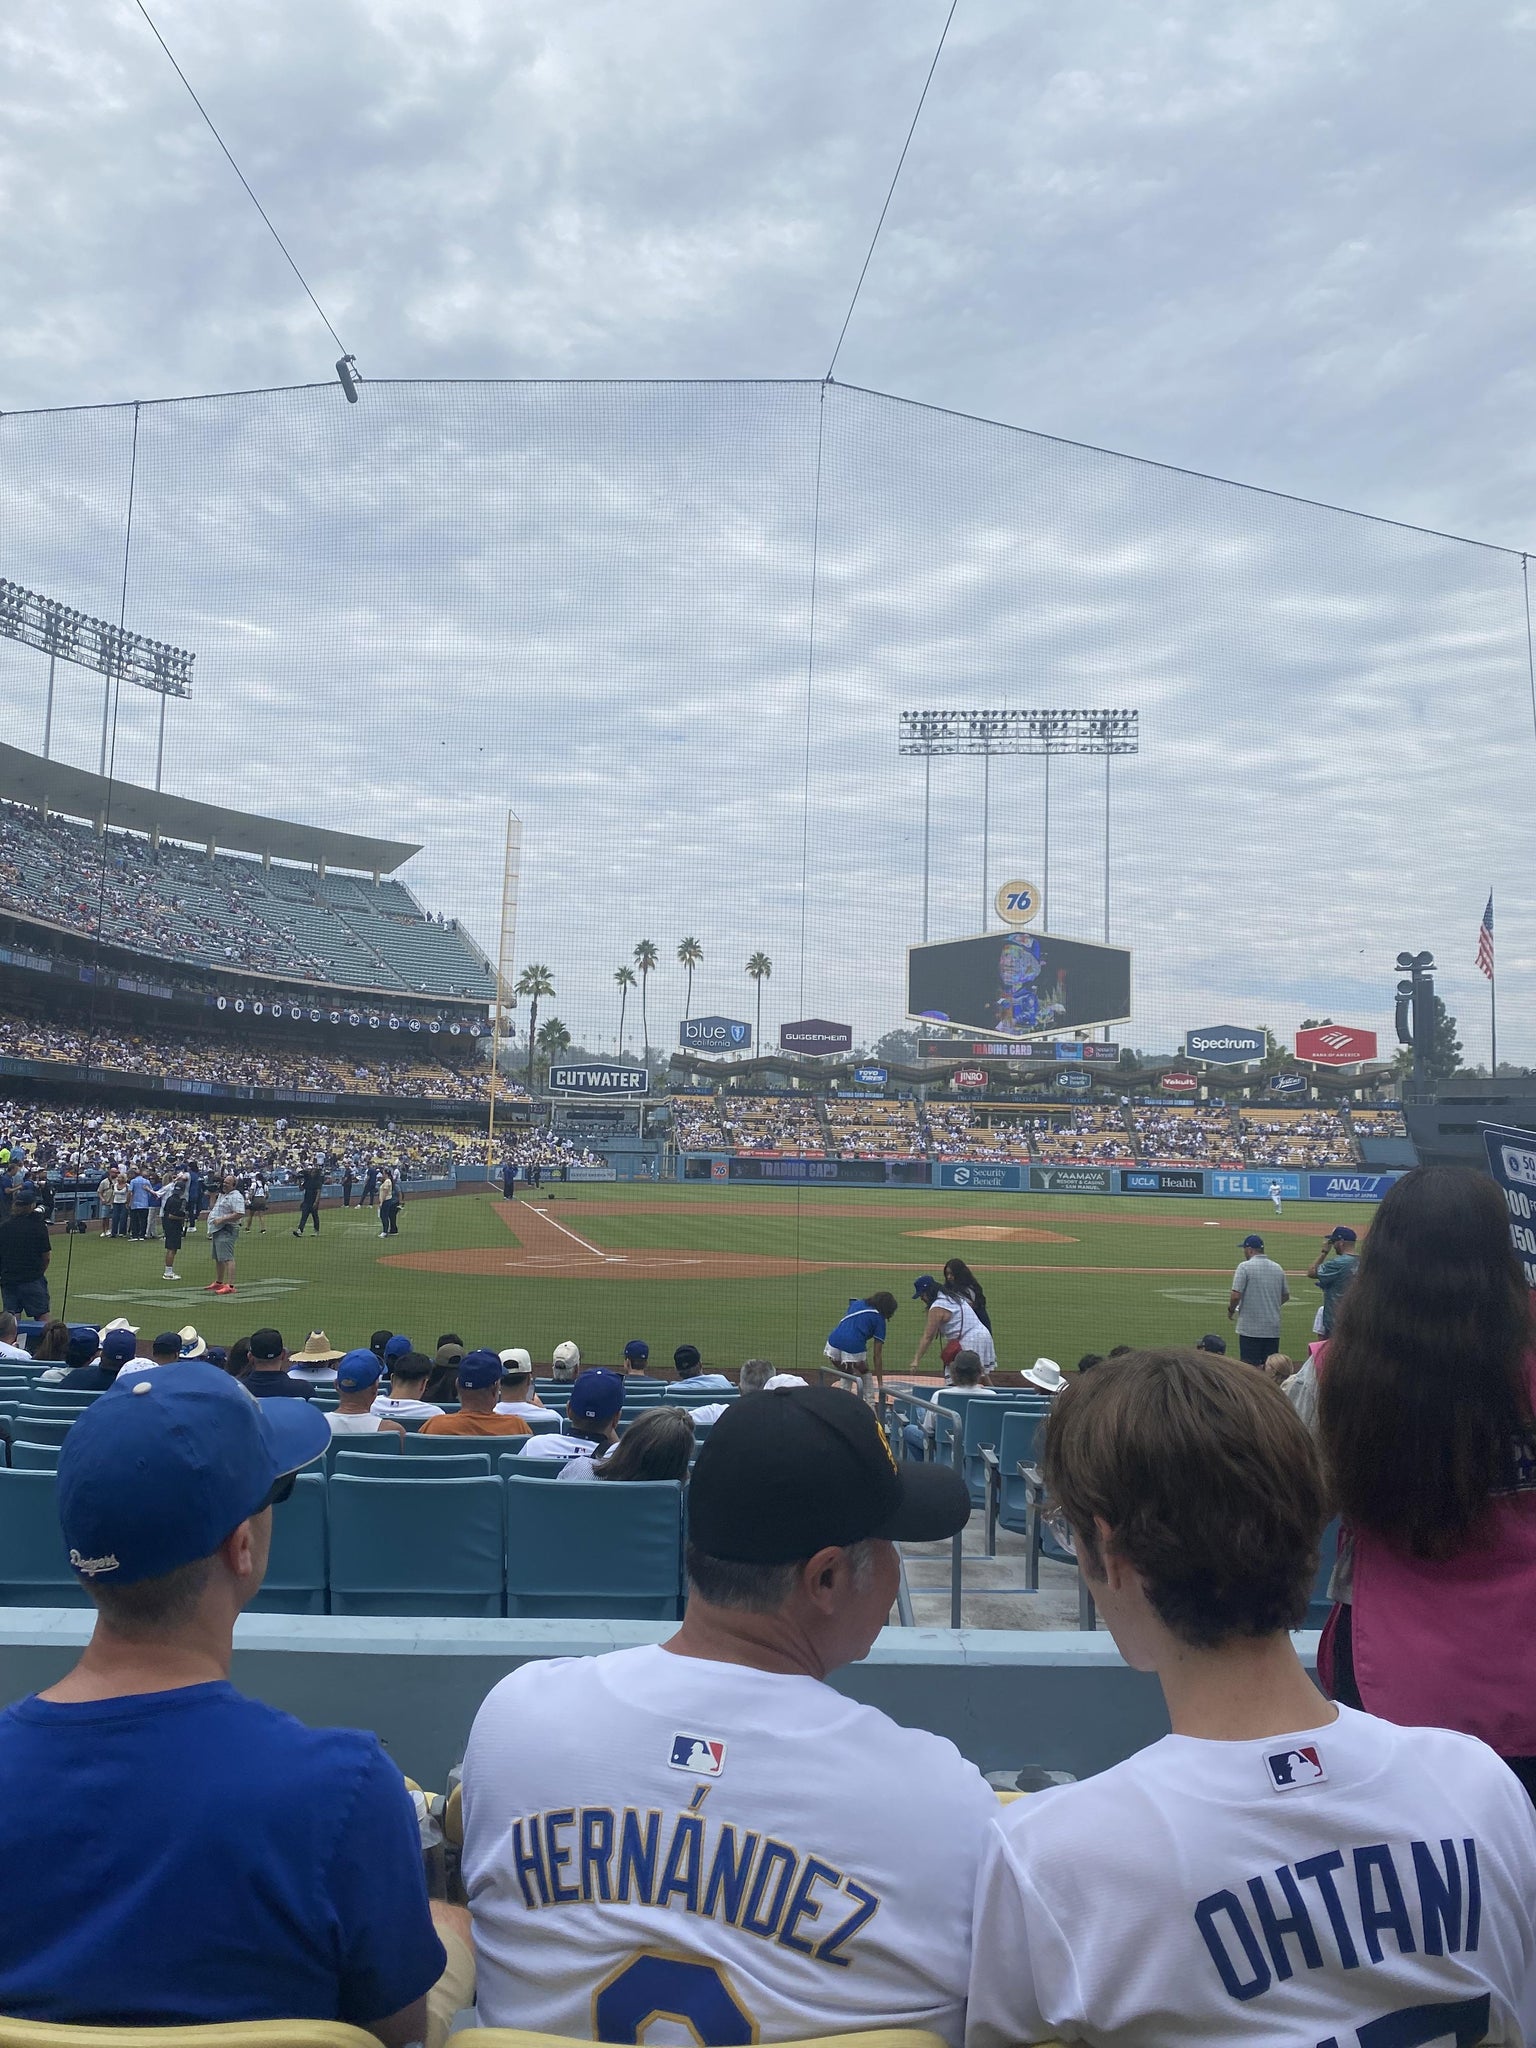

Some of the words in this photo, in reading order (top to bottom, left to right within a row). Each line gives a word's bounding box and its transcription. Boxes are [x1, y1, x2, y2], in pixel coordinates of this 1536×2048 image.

[1007, 891, 1031, 910] 76
[220, 999, 224, 1007] 1
[237, 1002, 242, 1010] 2
[256, 1005, 261, 1013] 4
[312, 1011, 319, 1020] 20
[331, 1013, 339, 1021] 24
[350, 1016, 359, 1024] 32
[370, 1018, 379, 1026] 34
[390, 1020, 399, 1028] 39
[410, 1022, 420, 1031] 42
[686, 1023, 725, 1039] blue
[786, 1033, 847, 1041] GUGGENHEIM
[1192, 1037, 1255, 1052] Spectrum
[972, 1044, 1007, 1055] TRADING
[1009, 1045, 1032, 1056] CARD
[557, 1071, 639, 1087] CUTWATER
[961, 1073, 982, 1082] JINRO
[715, 1166, 725, 1174] 76
[760, 1162, 806, 1177] TRADING
[973, 1168, 1006, 1179] Security
[973, 1177, 1003, 1187] Benefit
[1132, 1178, 1155, 1186] UCLA
[1162, 1178, 1197, 1188] Health
[1215, 1177, 1254, 1193] TEL
[1327, 1179, 1360, 1191] ANA
[1503, 1187, 1531, 1219] 00
[512, 1784, 880, 1967] HERNÁNDEZ
[1194, 1838, 1481, 2001] OHTANI
